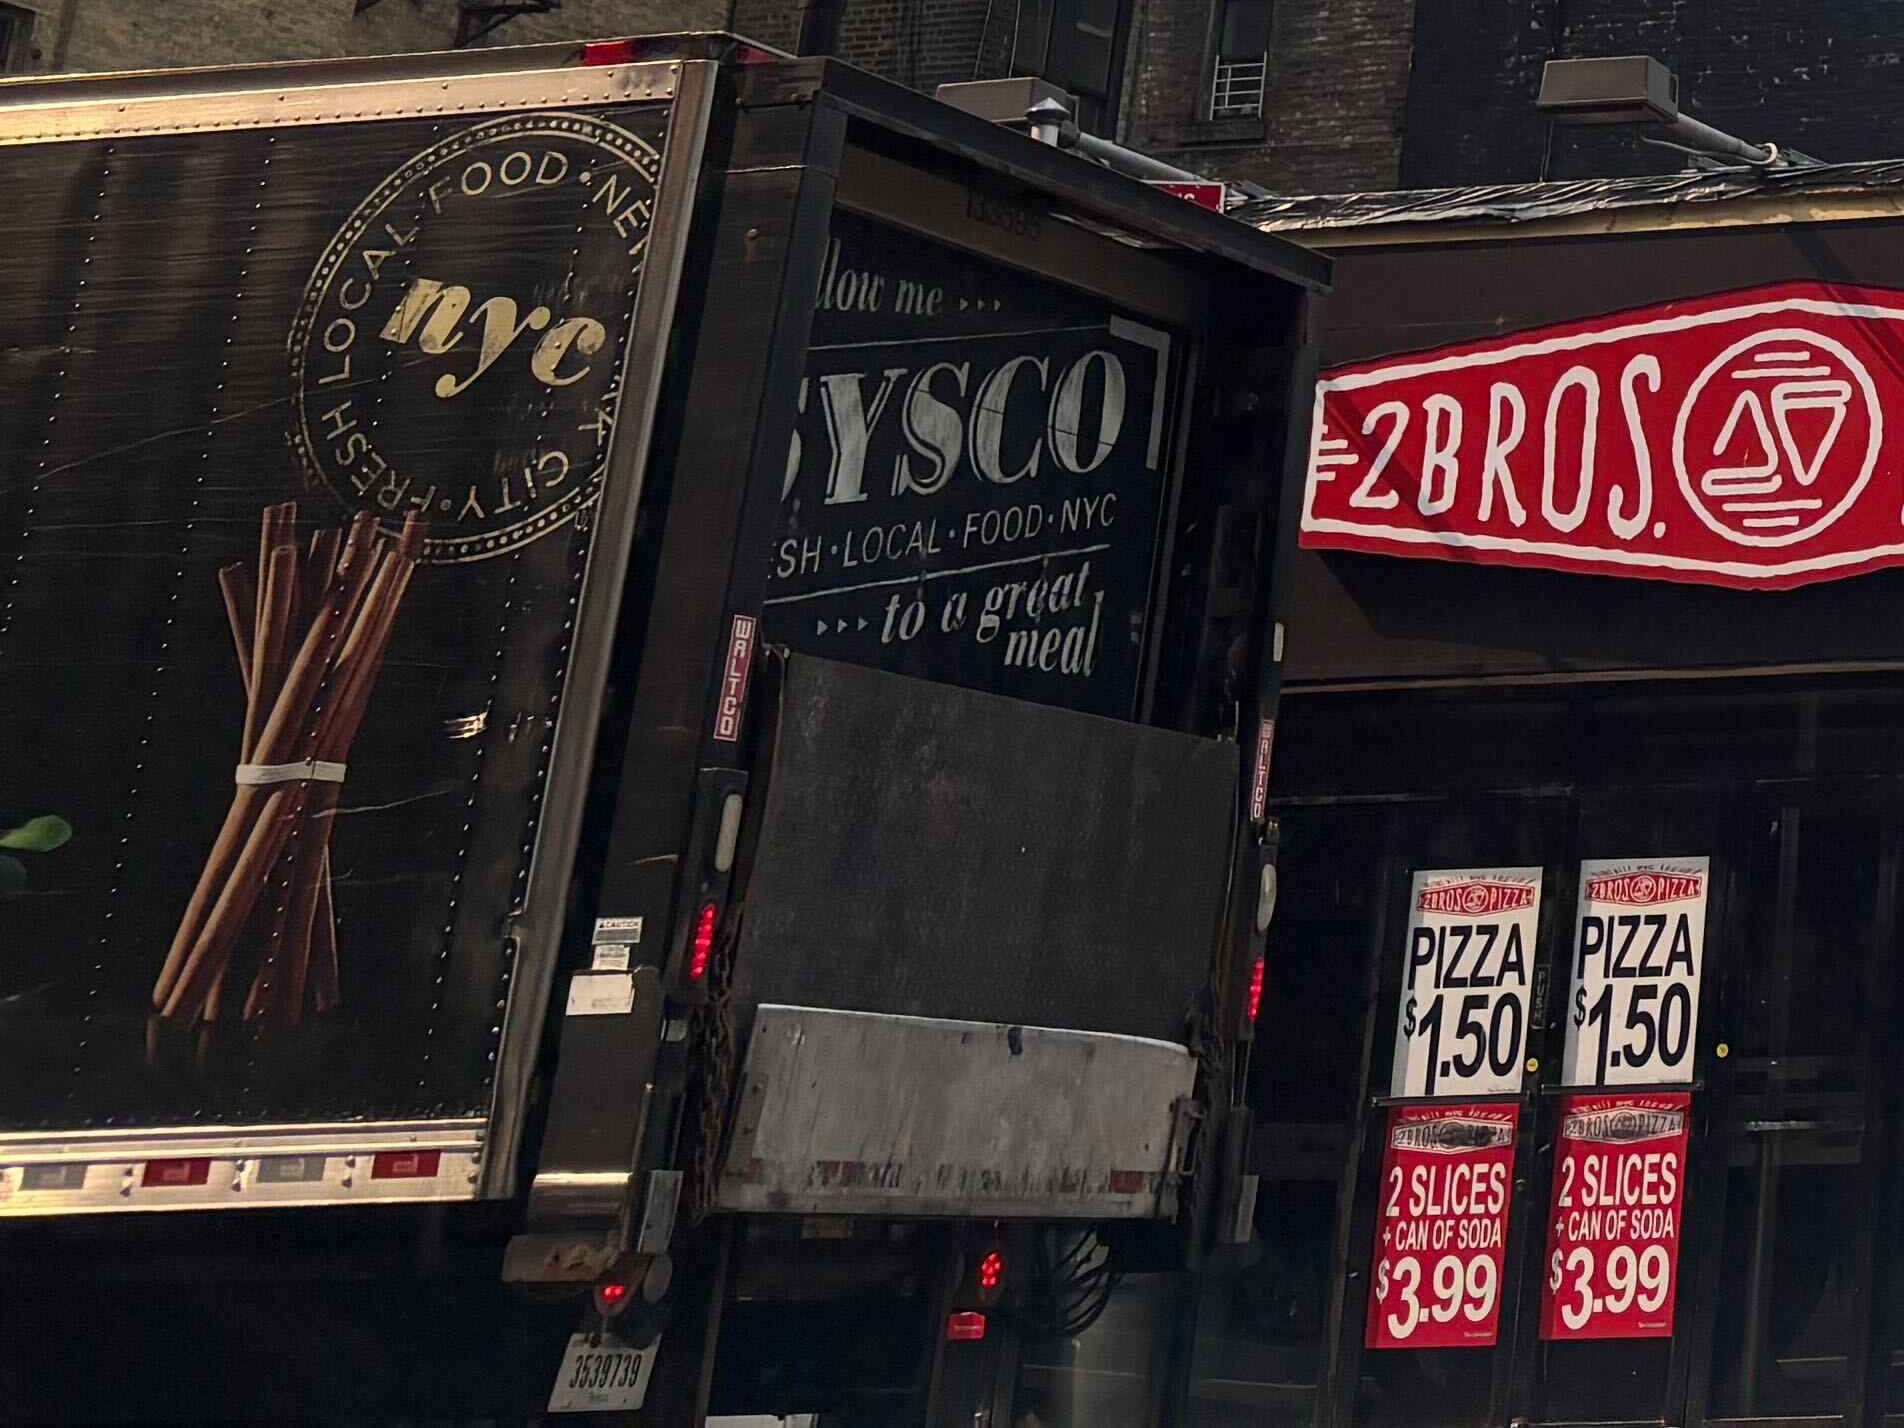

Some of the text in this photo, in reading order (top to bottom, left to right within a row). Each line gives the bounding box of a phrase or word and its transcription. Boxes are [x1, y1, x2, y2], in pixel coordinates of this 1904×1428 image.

[429, 151, 568, 215] FOOD
[318, 223, 420, 385] LOCAL
[895, 280, 943, 317] me
[379, 278, 606, 399] nyc
[320, 400, 436, 511] FRESH
[456, 450, 570, 522] CITY
[843, 521, 942, 568] LOCAL
[963, 505, 1041, 548] FOOD
[1060, 493, 1117, 532] NYC
[881, 561, 1090, 644] to a great
[1004, 590, 1104, 677] meal
[719, 620, 751, 736] WALTCO
[1408, 923, 1526, 990] PIZZA
[1577, 913, 1694, 979] PIZZA
[1403, 992, 1523, 1095] $1.50
[1573, 982, 1691, 1085] $1.50
[1386, 1162, 1506, 1217] 2 SLICES
[1558, 1152, 1678, 1207] 2 SLICES
[1395, 1219, 1428, 1250] CAN
[1432, 1219, 1455, 1250] OF
[1458, 1217, 1502, 1249] SODA
[1568, 1209, 1601, 1241] CAN
[1605, 1209, 1627, 1241] OF
[1630, 1207, 1675, 1240] SODA
[1376, 1253, 1497, 1339] $3.99
[1549, 1244, 1670, 1330] $3.99
